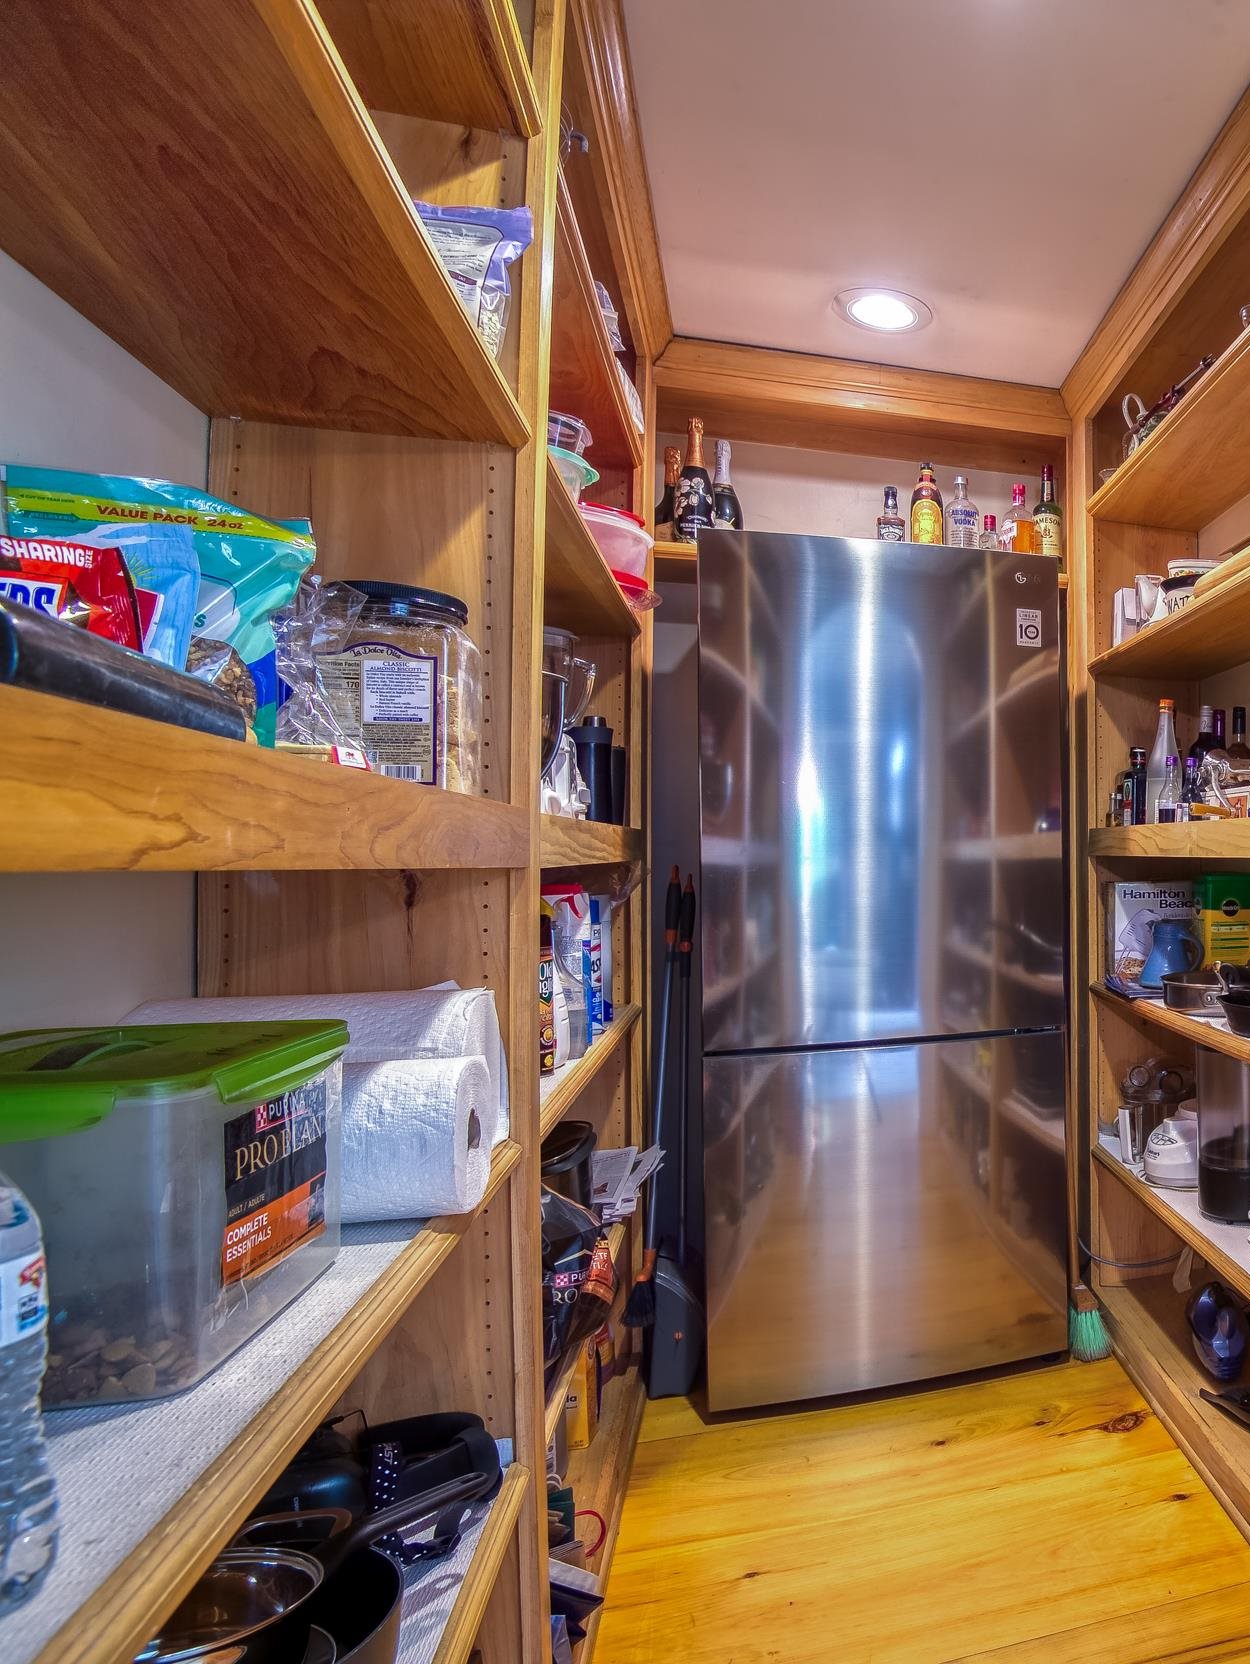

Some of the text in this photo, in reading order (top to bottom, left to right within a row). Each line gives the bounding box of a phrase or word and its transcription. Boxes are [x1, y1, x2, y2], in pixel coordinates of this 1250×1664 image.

[97, 505, 199, 526] VALUE PACK
[953, 518, 976, 527] VODKA
[1034, 516, 1061, 528] AMESON
[2, 538, 86, 569] SHARING
[84, 549, 94, 570] SIZE
[1019, 623, 1040, 640] 10
[1123, 888, 1186, 900] Hamilton
[1158, 899, 1195, 910] Beac
[234, 1114, 324, 1181] PRO PLAN
[226, 1211, 270, 1246] COMPLETE
[226, 1225, 273, 1263] ESSENTIALS
